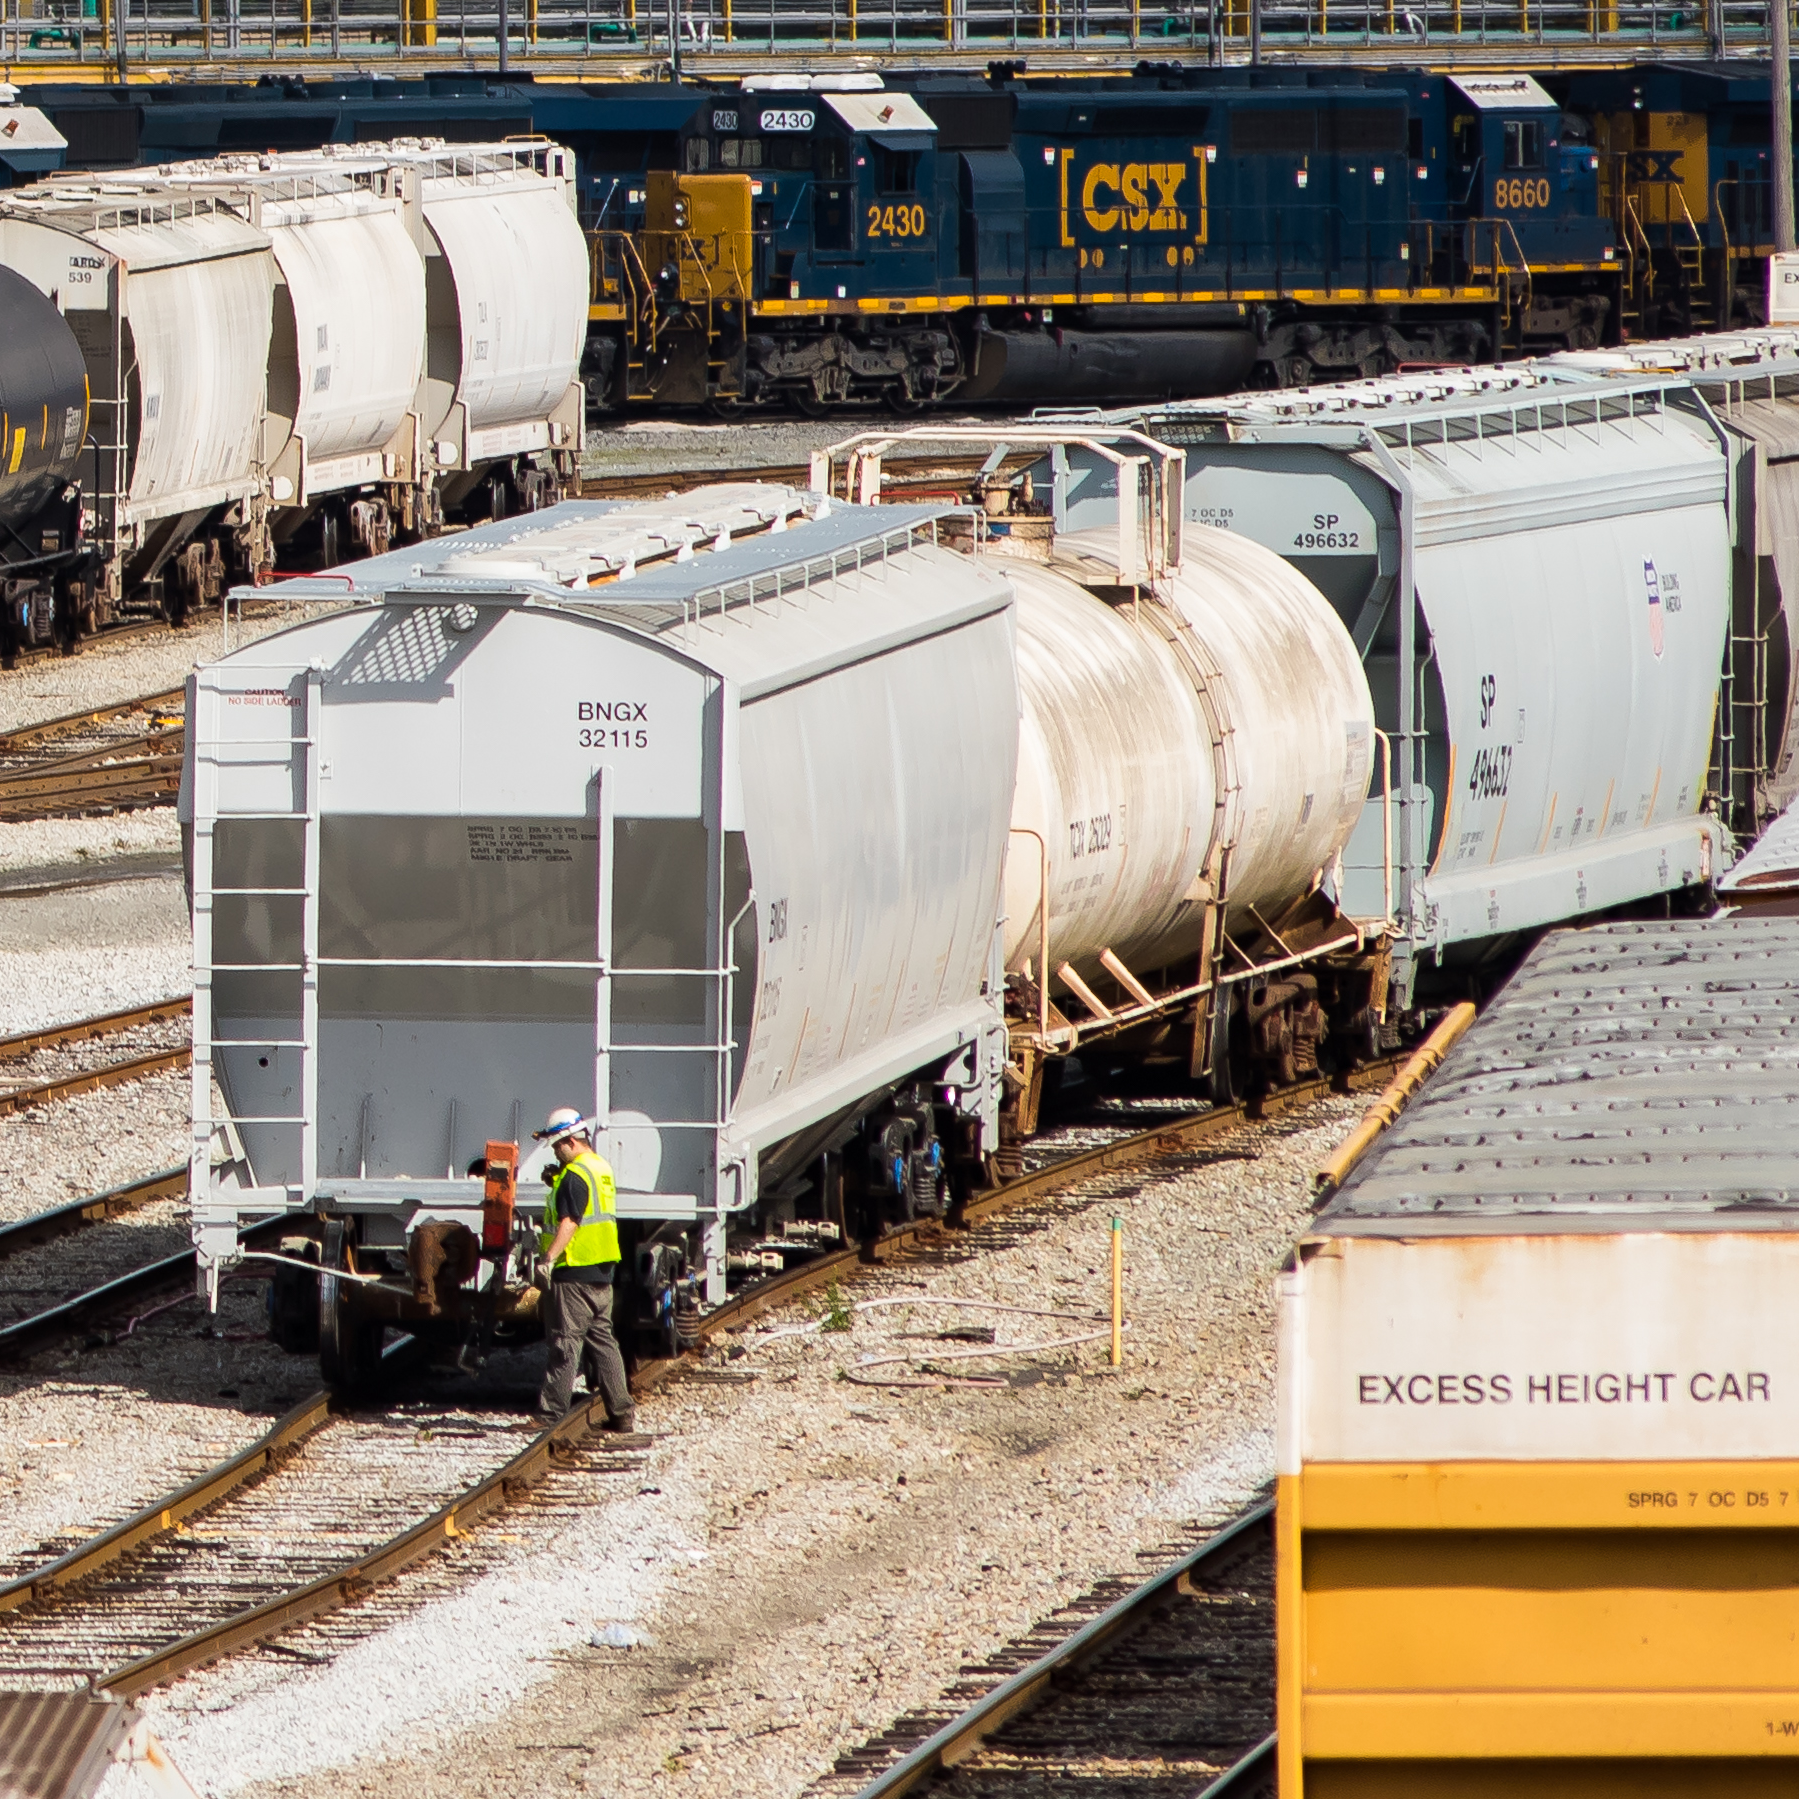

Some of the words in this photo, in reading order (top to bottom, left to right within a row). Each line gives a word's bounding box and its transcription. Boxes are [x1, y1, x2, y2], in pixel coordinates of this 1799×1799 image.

[714, 111, 737, 130] 2430
[763, 111, 812, 130] 2430
[1628, 150, 1685, 183] SX
[1082, 163, 1187, 232] CSX
[1495, 178, 1551, 208] 8660
[867, 205, 926, 238] 2430
[69, 272, 92, 283] 539
[1201, 509, 1216, 517] OC
[1220, 509, 1234, 517] D5
[1314, 514, 1339, 530] SP
[1294, 532, 1359, 549] 496632
[228, 697, 241, 705] NO
[244, 697, 264, 705] SIDE
[578, 701, 648, 722] BNGX
[1481, 674, 1497, 729] SP
[578, 728, 648, 749] 32115
[1470, 745, 1512, 801] 496632
[1359, 1374, 1512, 1405] EXCESS
[1527, 1372, 1677, 1405] HEIGHT
[1690, 1371, 1772, 1403] CAR
[1628, 1492, 1678, 1508] SPRG
[1688, 1492, 1698, 1508] 7
[1708, 1492, 1736, 1508] OC
[1747, 1491, 1769, 1507] D5
[1779, 1491, 1789, 1507] 7
